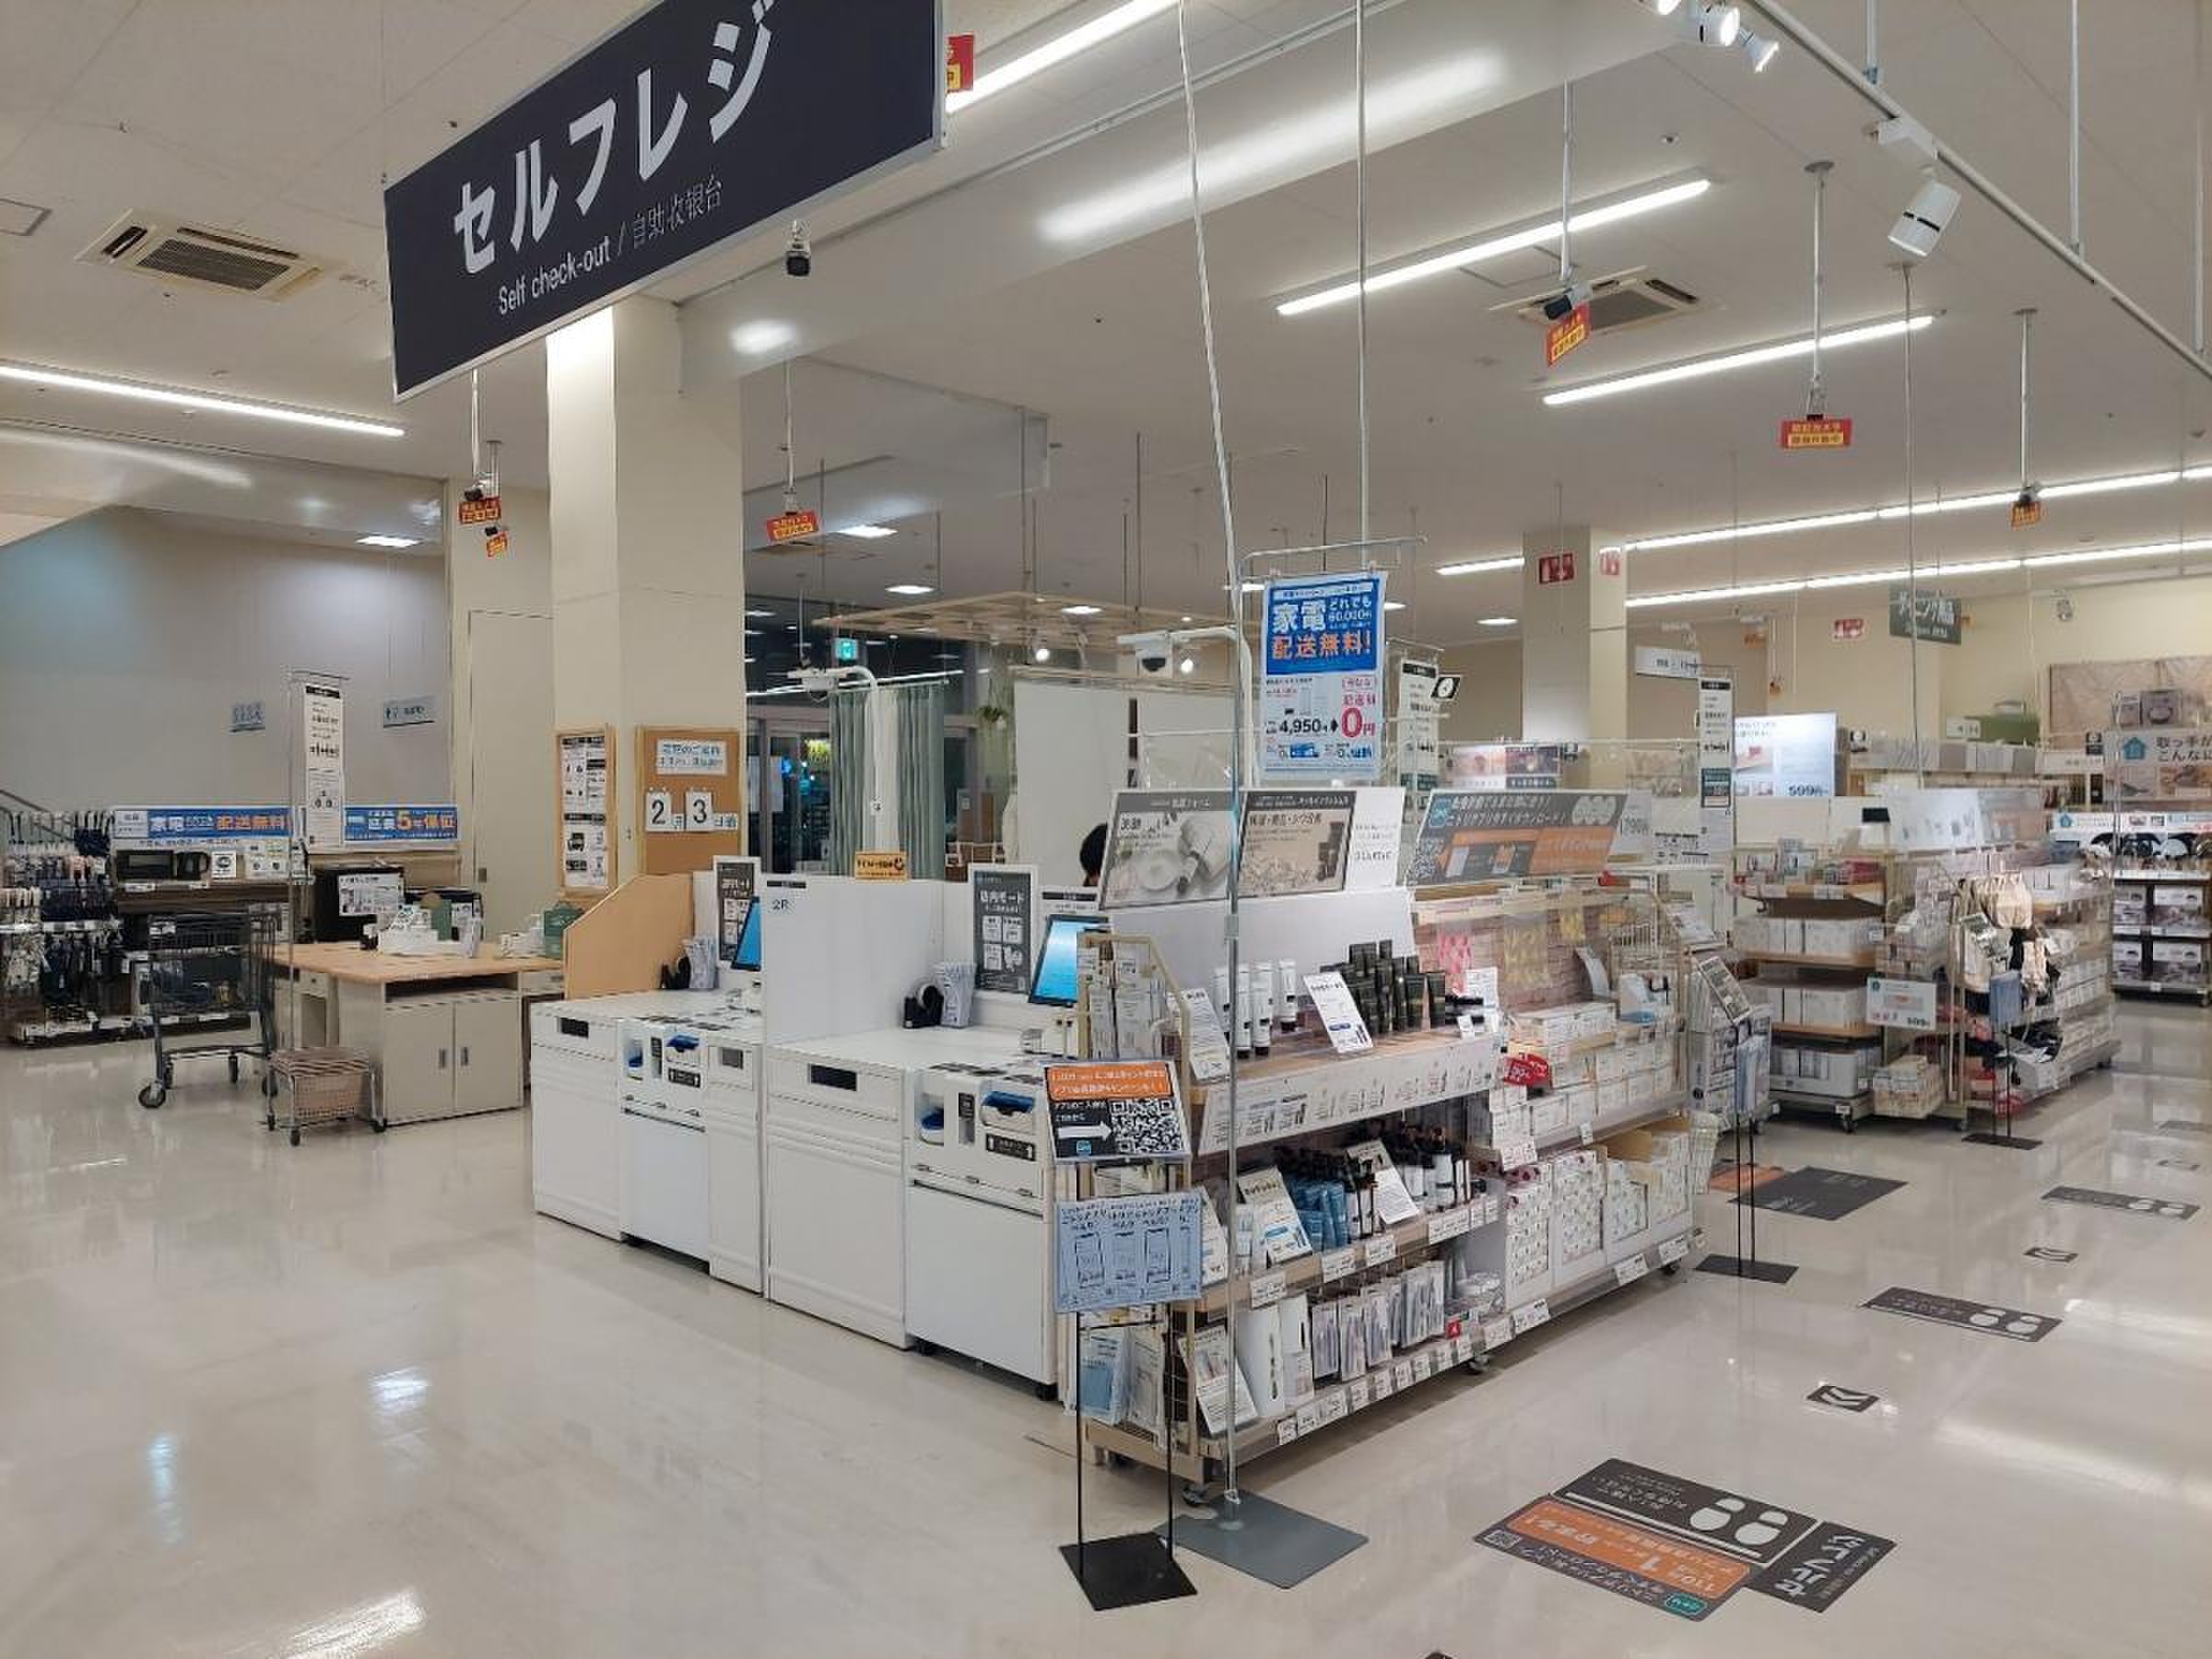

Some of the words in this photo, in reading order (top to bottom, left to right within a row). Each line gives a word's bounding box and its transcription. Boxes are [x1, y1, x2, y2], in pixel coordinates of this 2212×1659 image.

[453, 0, 776, 275] セルフレジ
[499, 275, 526, 314] Self
[532, 236, 610, 299] check-out
[1272, 600, 1326, 634] 家電
